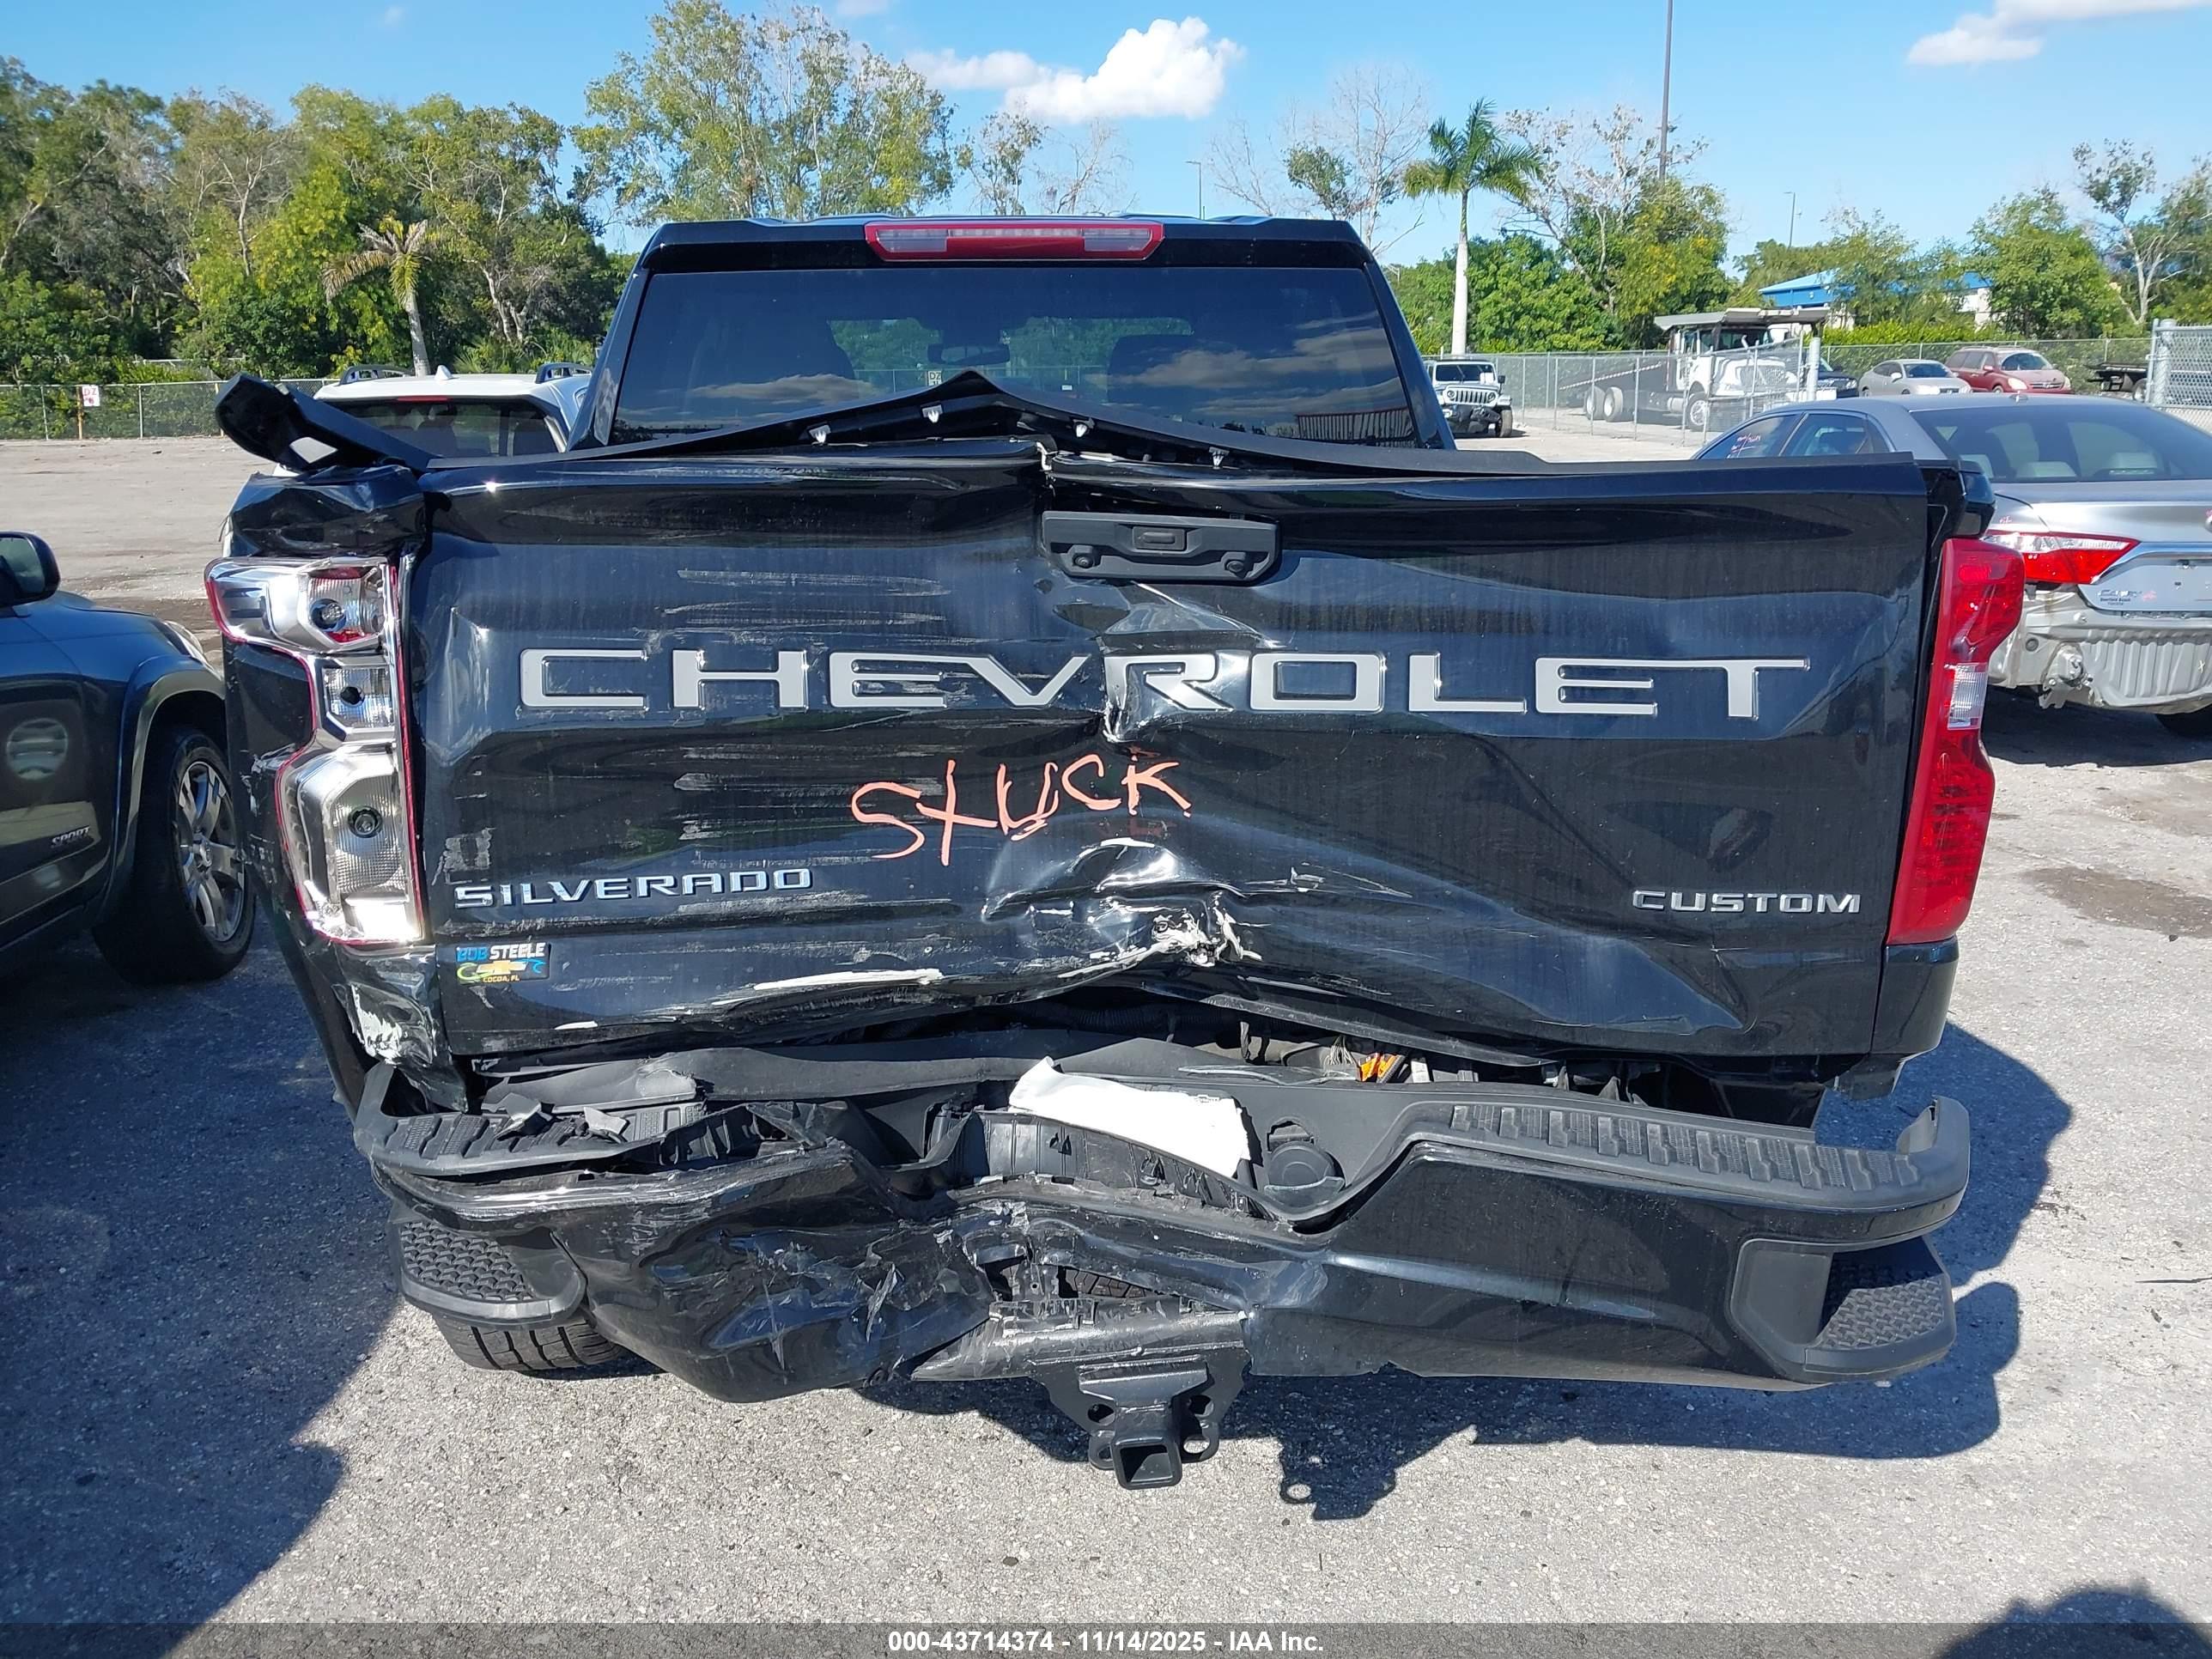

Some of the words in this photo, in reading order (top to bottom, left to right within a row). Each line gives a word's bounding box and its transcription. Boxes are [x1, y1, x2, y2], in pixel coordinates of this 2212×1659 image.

[520, 647, 1810, 721] CHEVROLET
[454, 867, 814, 908] SILVERADO
[1632, 890, 1862, 914] CUSTOM
[456, 946, 488, 962] BOB
[489, 942, 546, 960] STEELE
